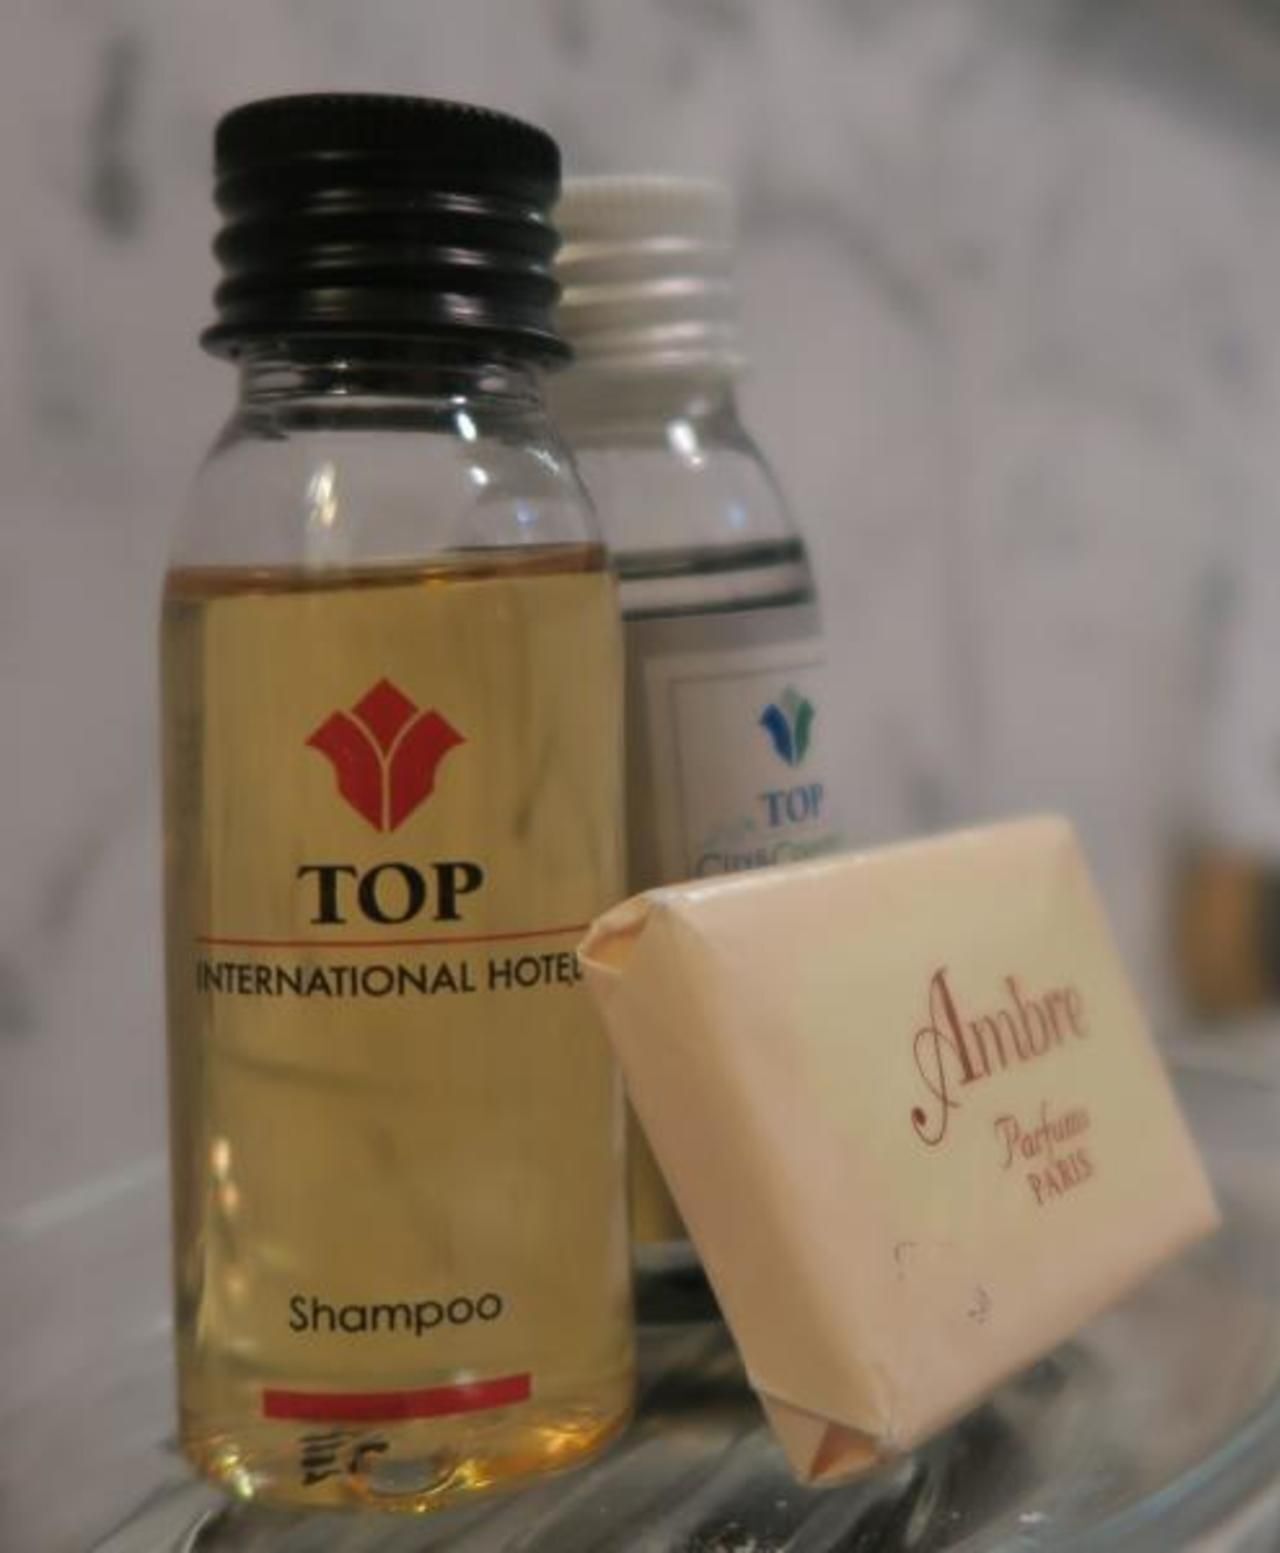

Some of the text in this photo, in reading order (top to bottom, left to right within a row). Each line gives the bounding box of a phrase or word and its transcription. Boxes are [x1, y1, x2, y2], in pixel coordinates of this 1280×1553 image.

[760, 783, 823, 828] TOP
[297, 862, 483, 925] TOP
[197, 956, 475, 998] INTERNATIONAL
[911, 967, 1089, 1147] Ambre
[1027, 1149, 1094, 1206] PARIS
[289, 1294, 503, 1337] Shampoo
